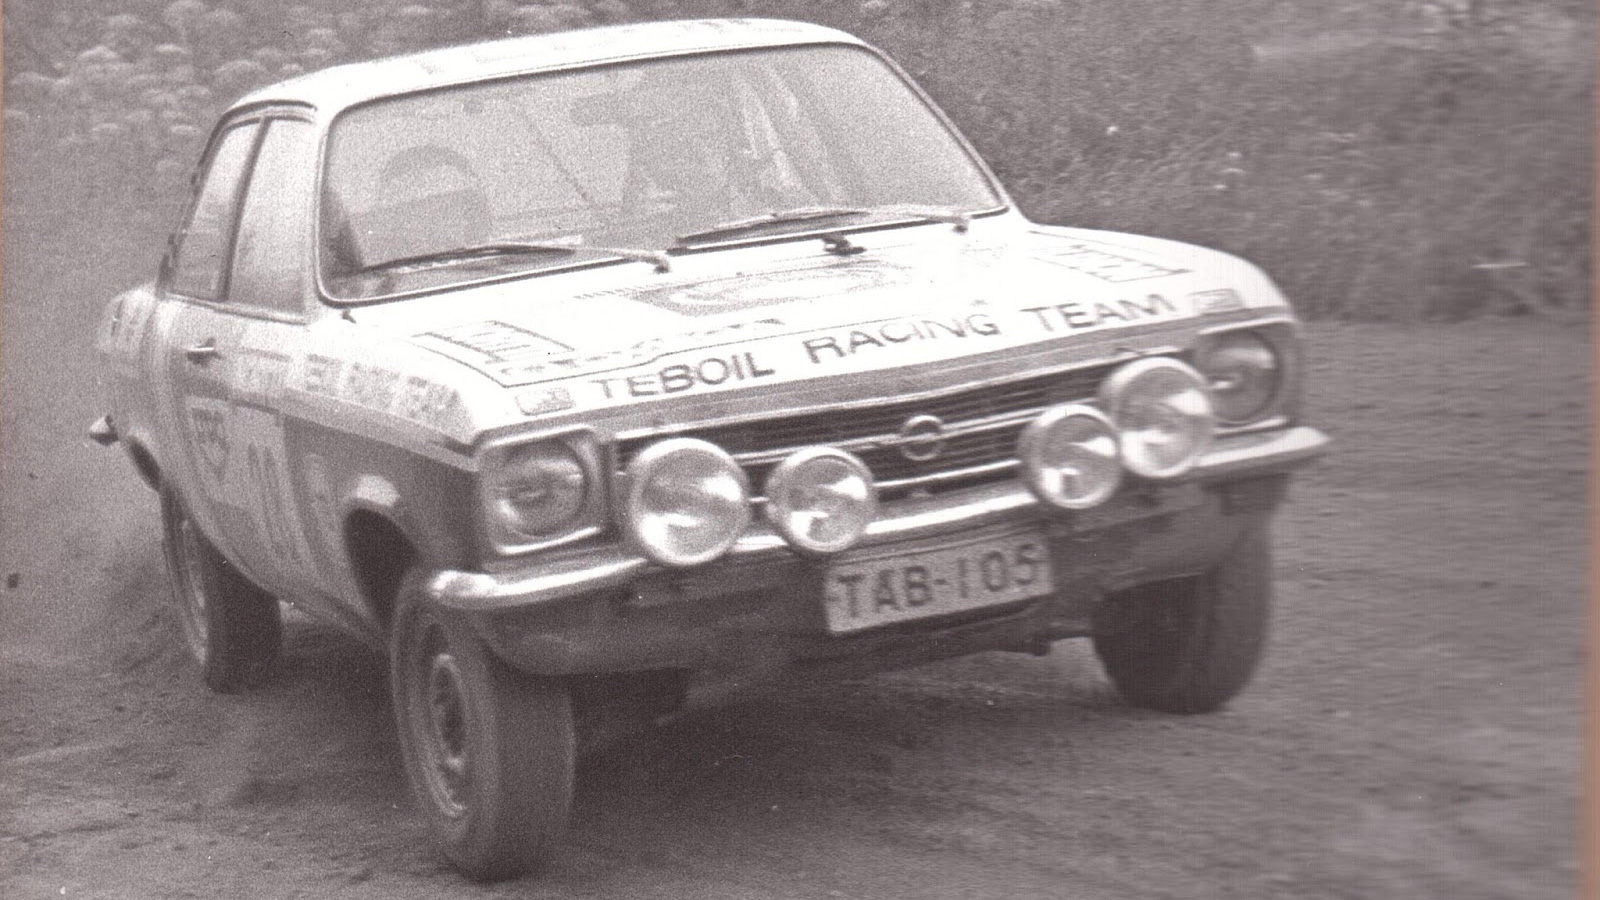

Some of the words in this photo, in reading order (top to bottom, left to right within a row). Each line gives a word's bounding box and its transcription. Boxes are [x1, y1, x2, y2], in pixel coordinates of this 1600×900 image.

[588, 351, 775, 399] TEBOIL
[801, 312, 1000, 364] RACING
[1020, 293, 1177, 333] TEAM
[836, 542, 1040, 618] TAB-105
